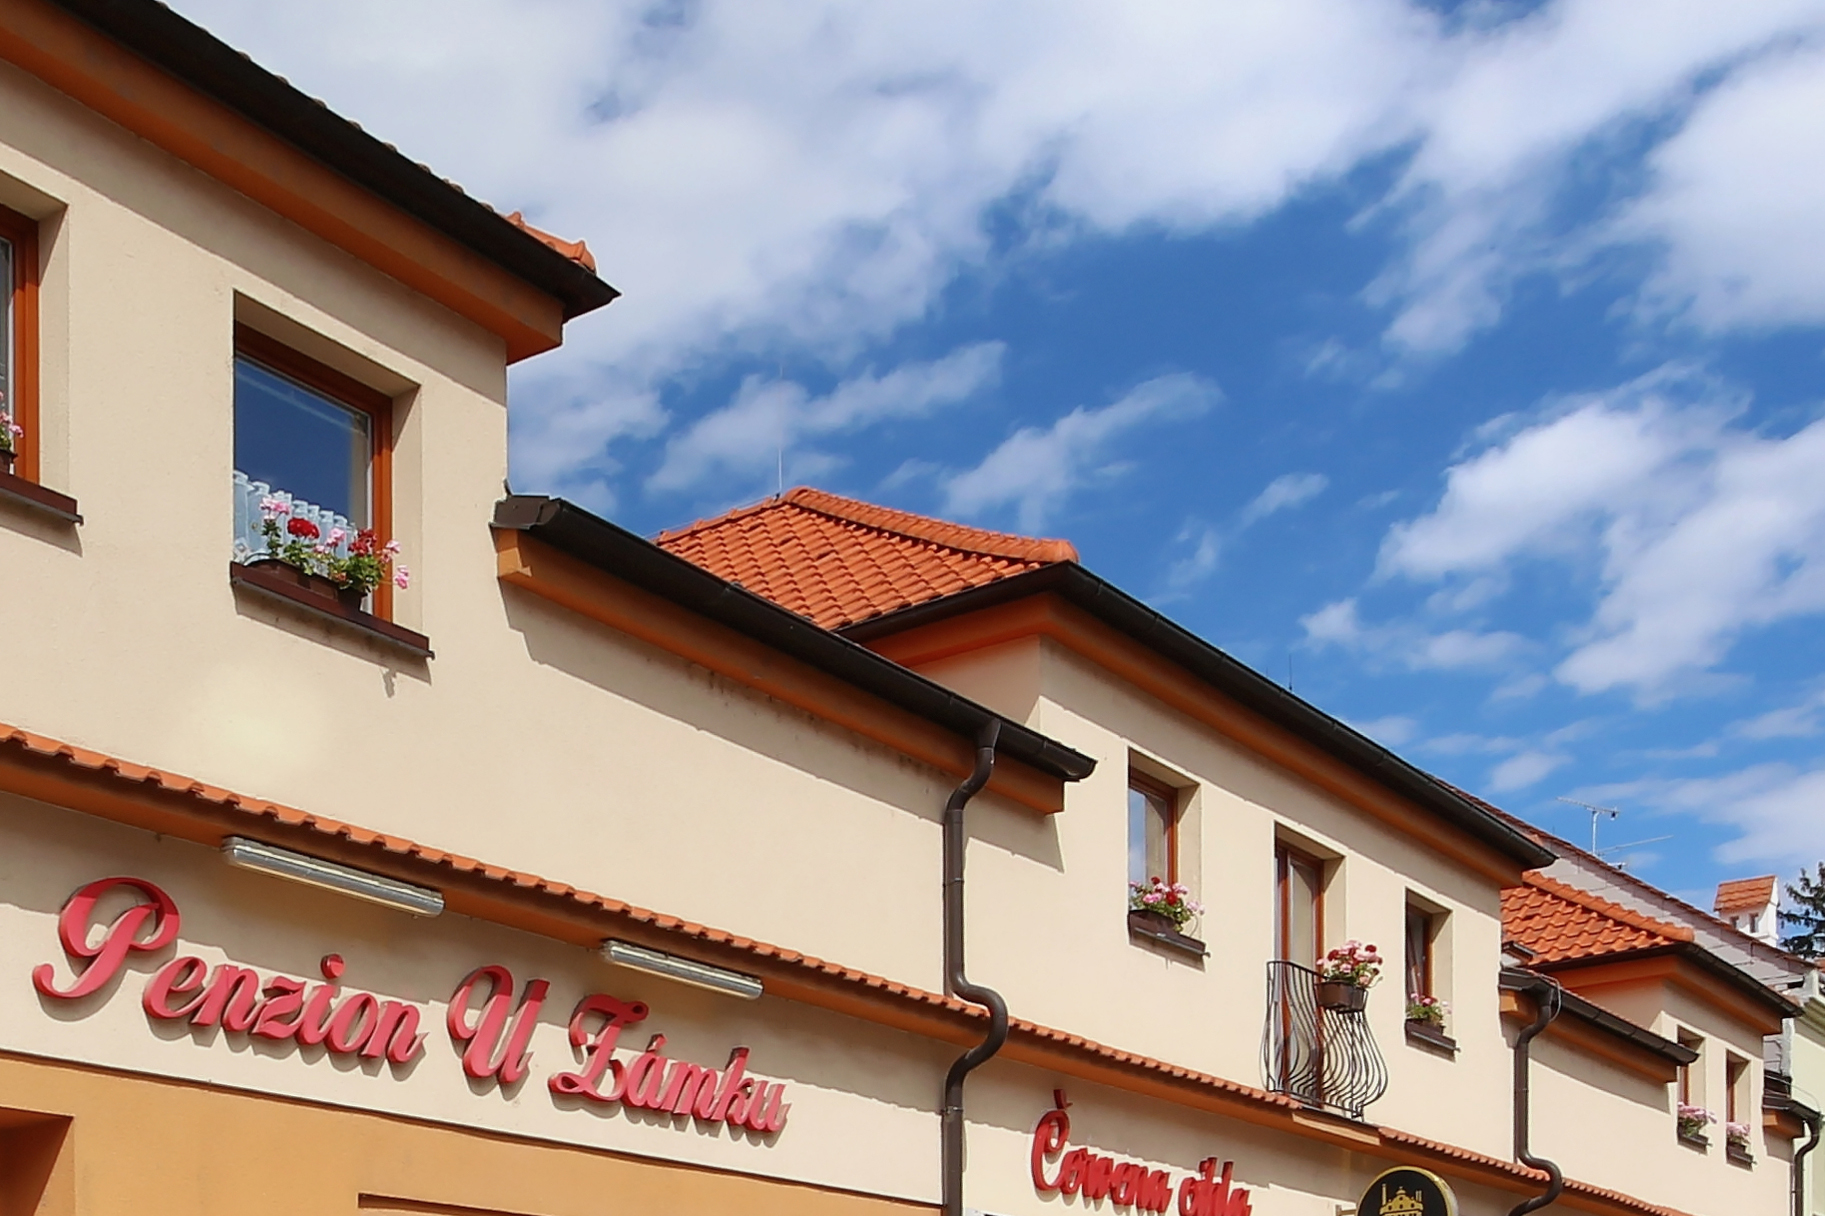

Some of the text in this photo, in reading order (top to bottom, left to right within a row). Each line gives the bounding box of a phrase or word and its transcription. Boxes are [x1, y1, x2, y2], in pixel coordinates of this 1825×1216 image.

[32, 876, 791, 1133] Penzion U Zámku
